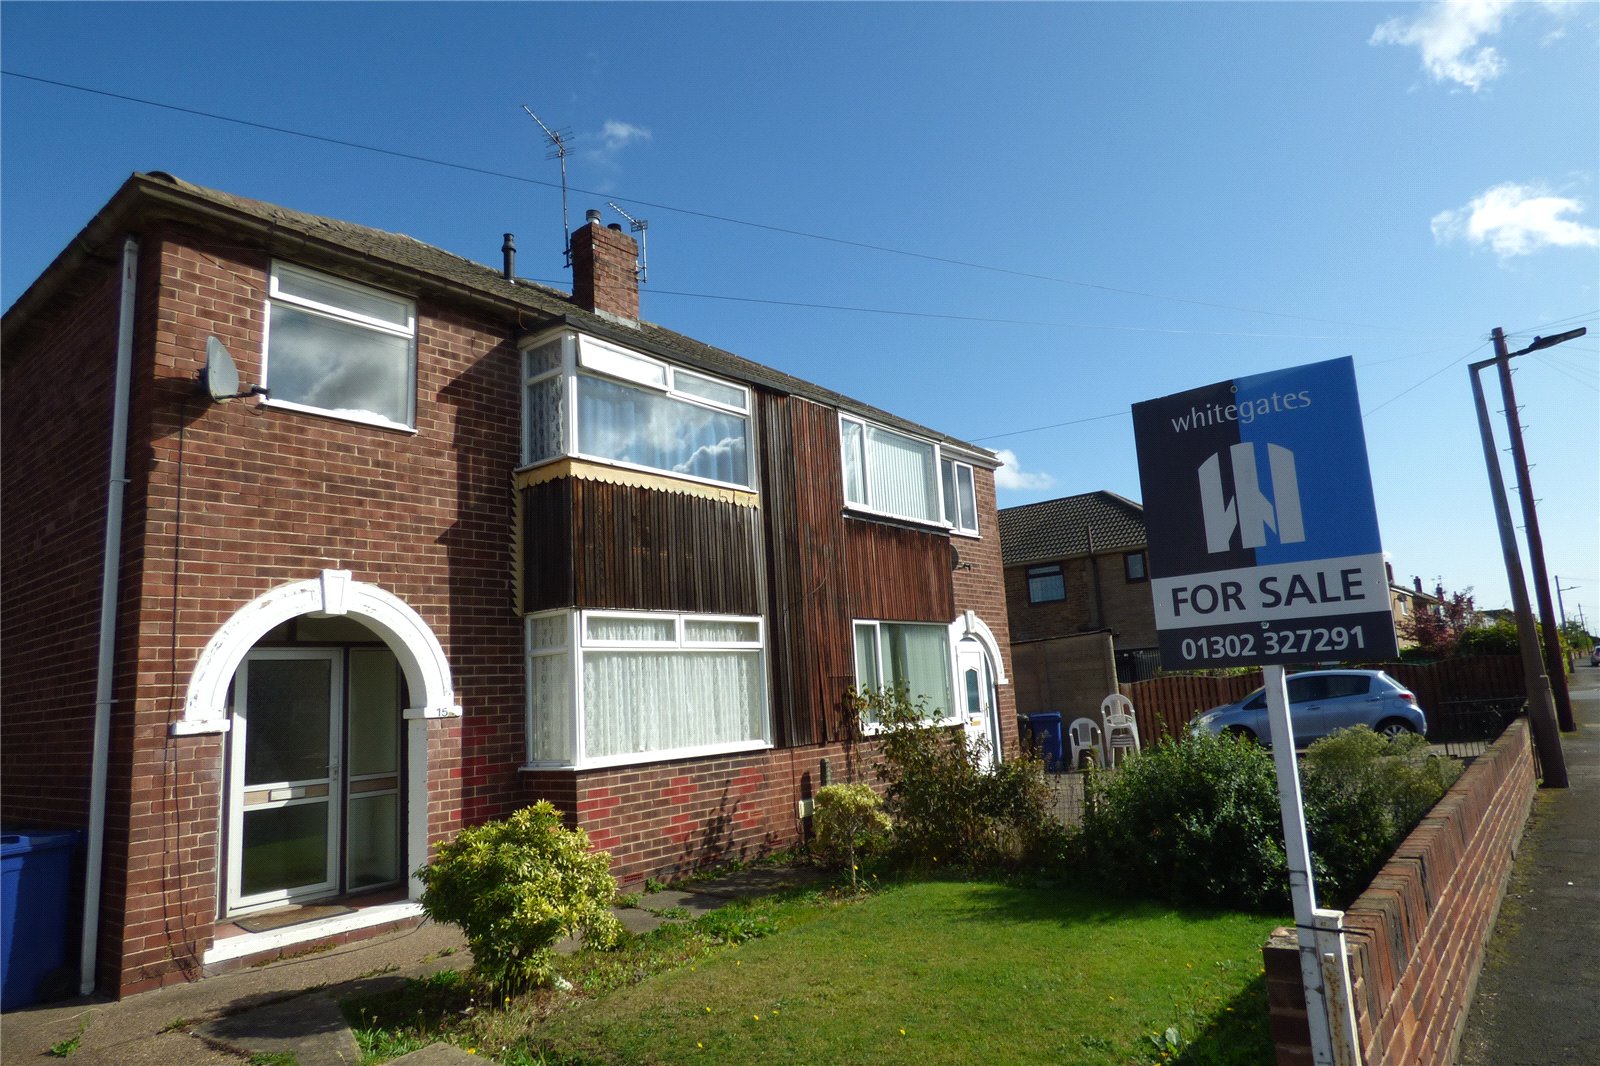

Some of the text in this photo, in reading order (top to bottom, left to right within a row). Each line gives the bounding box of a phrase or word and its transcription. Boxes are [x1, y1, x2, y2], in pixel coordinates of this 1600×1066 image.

[1171, 390, 1312, 433] whitegates
[1171, 568, 1366, 617] FOR SALE
[1181, 625, 1365, 660] 01302 327291
[436, 707, 448, 717] 15
